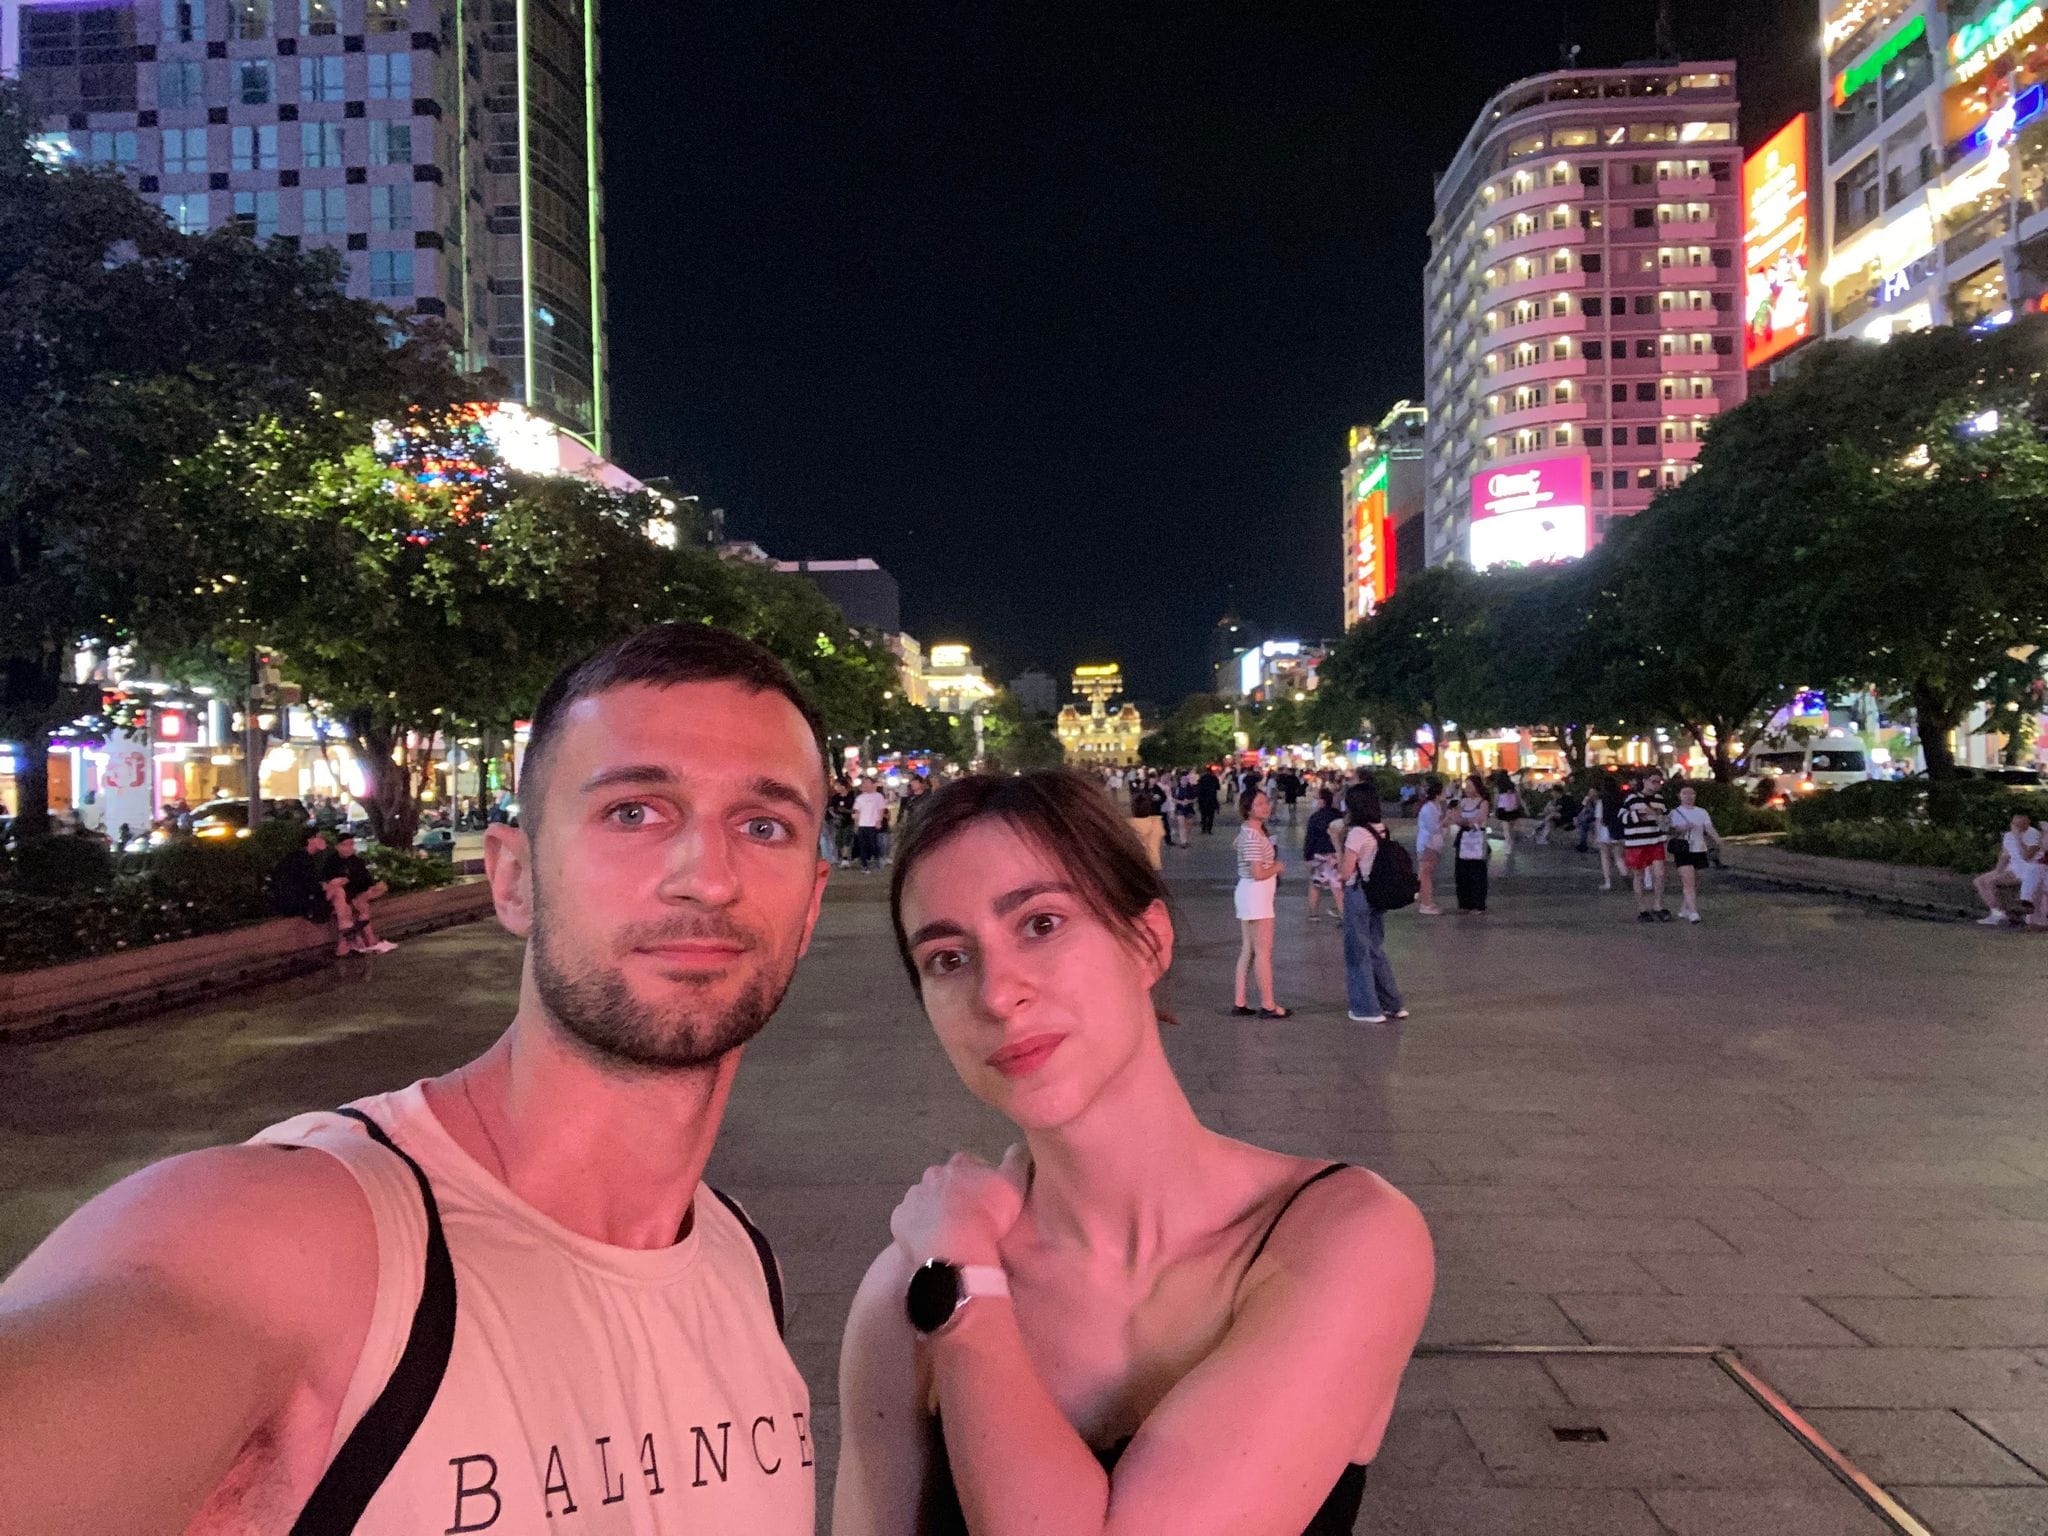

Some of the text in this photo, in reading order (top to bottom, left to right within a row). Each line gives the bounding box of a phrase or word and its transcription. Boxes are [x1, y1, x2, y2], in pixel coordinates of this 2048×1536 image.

[1955, 50, 1988, 83] THE
[1986, 6, 2044, 61] LETTER
[445, 1411, 813, 1536] BALANCE
